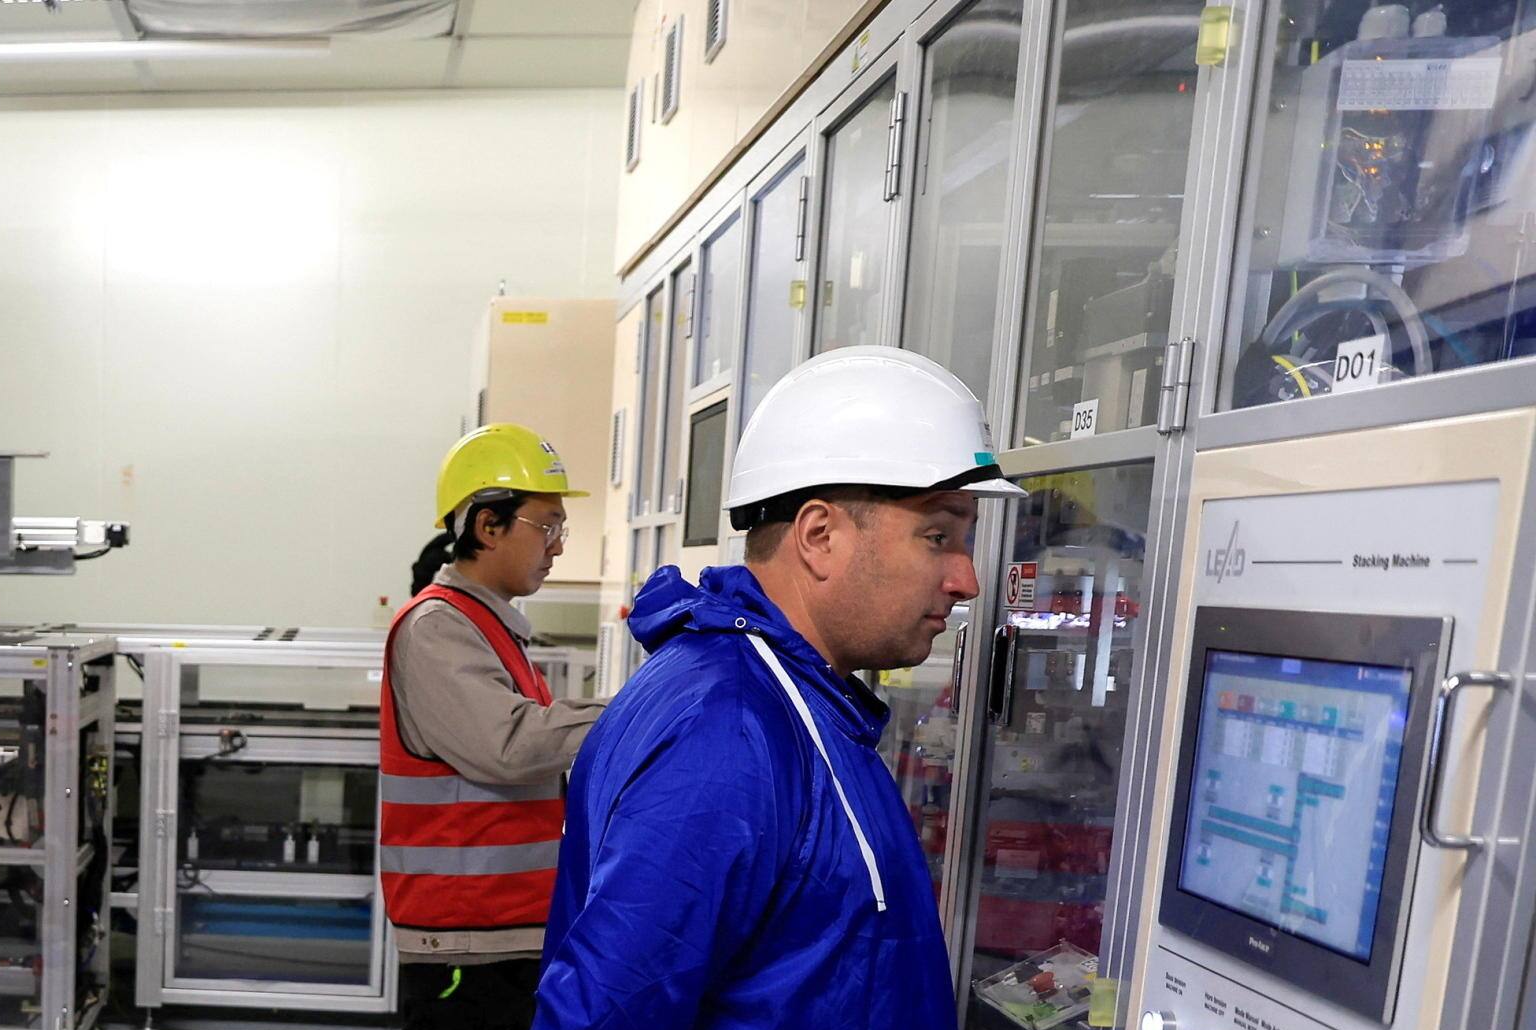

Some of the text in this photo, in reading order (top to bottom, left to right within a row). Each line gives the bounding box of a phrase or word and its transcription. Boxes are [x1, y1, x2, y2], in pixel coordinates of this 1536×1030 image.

[1336, 349, 1376, 381] D01
[1074, 409, 1093, 431] D35
[1352, 553, 1430, 571] Stacking Machine
